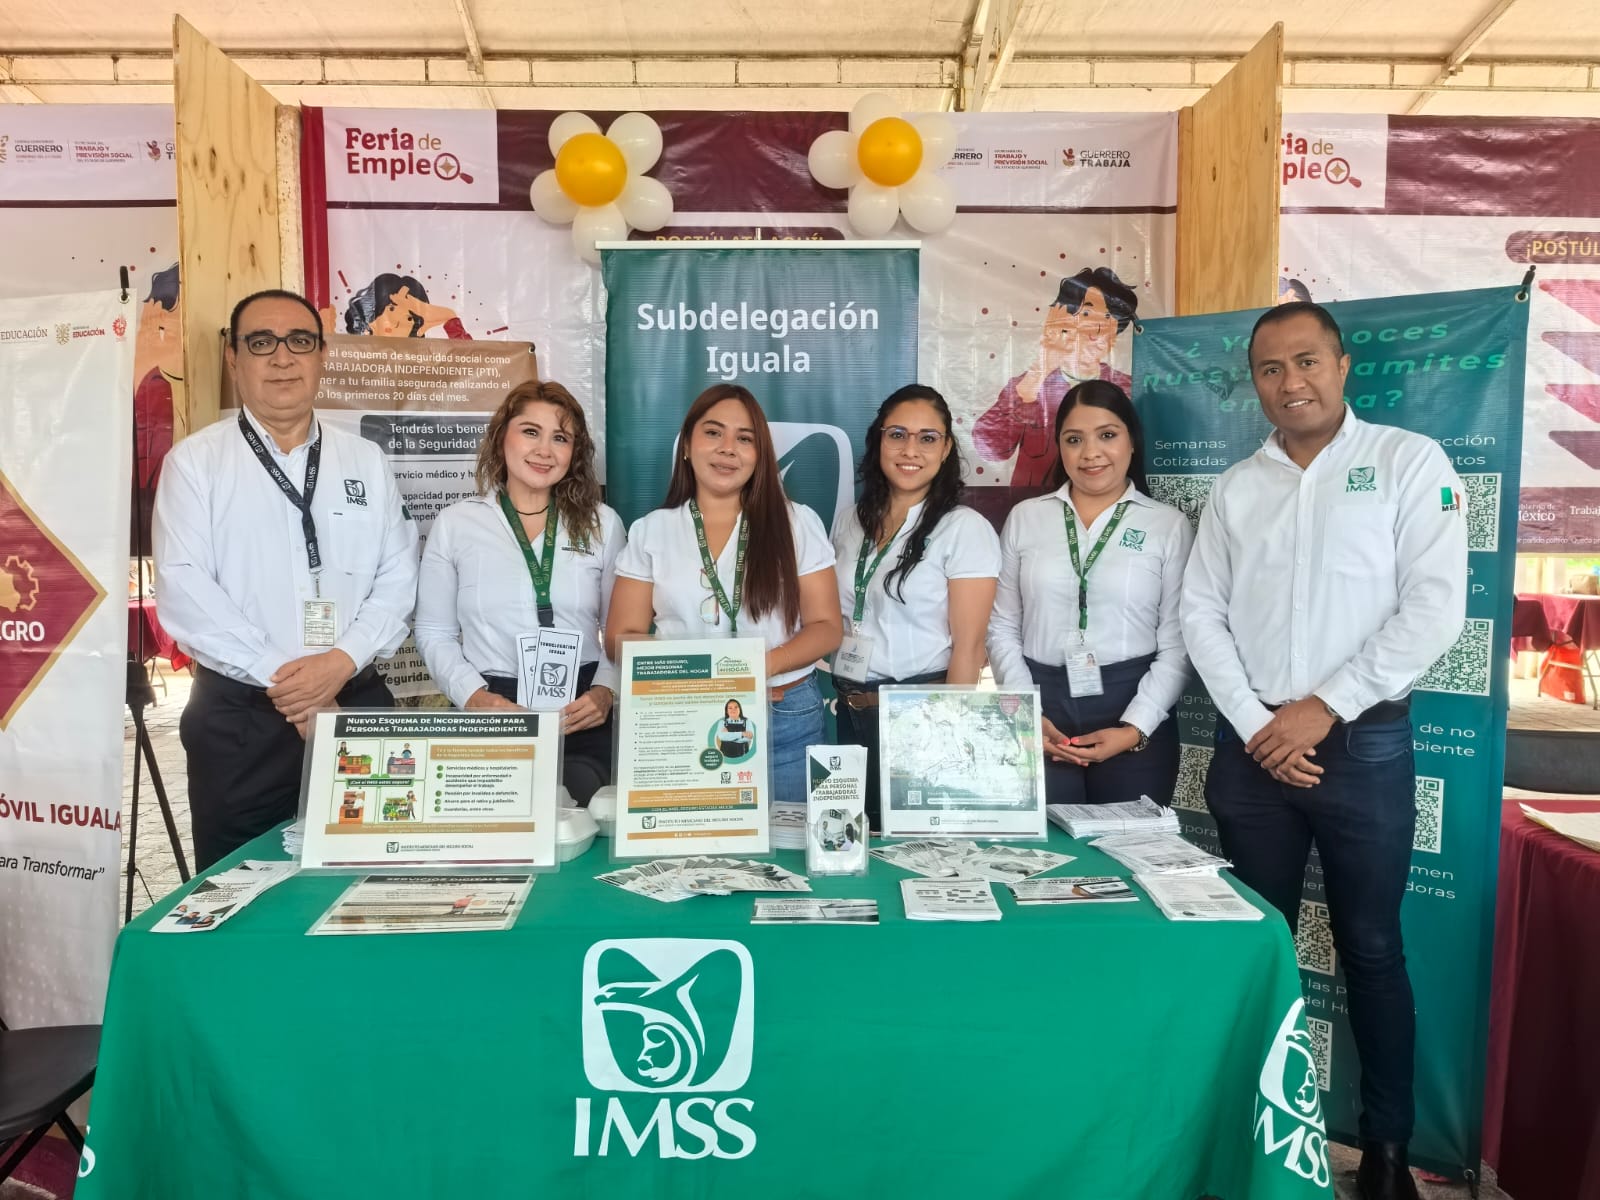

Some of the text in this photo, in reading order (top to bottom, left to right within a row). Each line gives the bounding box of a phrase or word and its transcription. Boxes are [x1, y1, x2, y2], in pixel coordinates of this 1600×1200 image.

[345, 128, 441, 151] Feria de
[1281, 133, 1333, 155] ia de
[15, 144, 63, 153] GUERRERO
[1080, 150, 1131, 159] GUERRERO
[1080, 159, 1131, 168] TRABAJA
[1283, 157, 1351, 185] pleo
[637, 302, 879, 338] Subdelegación
[0, 326, 48, 340] EDUCACIÓN
[1342, 322, 1448, 344] oces
[329, 348, 511, 364] al esquema de seguridad social como
[706, 345, 811, 381] Iguala
[323, 361, 392, 374] RABAJADORA
[394, 364, 473, 376] INDEPENDIENTE
[1354, 353, 1507, 376] amites
[320, 377, 336, 385] ner
[348, 377, 358, 385] tu
[361, 376, 395, 387] familia
[397, 379, 447, 390] asegurada
[450, 380, 499, 389] realizando
[501, 380, 510, 389] el
[327, 389, 342, 399] los
[345, 389, 390, 401] primeros
[392, 391, 404, 400] 20
[406, 391, 427, 401] días
[429, 393, 444, 401] del
[1343, 389, 1403, 408] a?
[390, 423, 490, 434] Tendrás los benef
[388, 439, 476, 451] de la Seguridad
[1155, 434, 1496, 449] Semanas ección
[1153, 456, 1228, 467] Cotizadas
[394, 469, 466, 480] ervicio médico y
[1346, 484, 1377, 493] IMSS
[346, 497, 368, 507] IMSS
[402, 490, 460, 502] apacidad por
[1569, 505, 1600, 516] Trabaj
[1119, 541, 1143, 551] IMSS
[1471, 584, 1489, 596] P.
[0, 620, 45, 641] GRO
[394, 661, 406, 670] un
[386, 672, 432, 686] egurida
[537, 685, 567, 698] IMSS
[1419, 723, 1476, 738] de no
[1413, 740, 1476, 757] biente
[0, 793, 121, 833] ÓVIL IGUALA
[0, 856, 18, 869] ara
[1410, 865, 1454, 881] men
[1405, 881, 1456, 899] doras
[1308, 978, 1330, 993] las
[573, 1097, 757, 1160] IMSS
